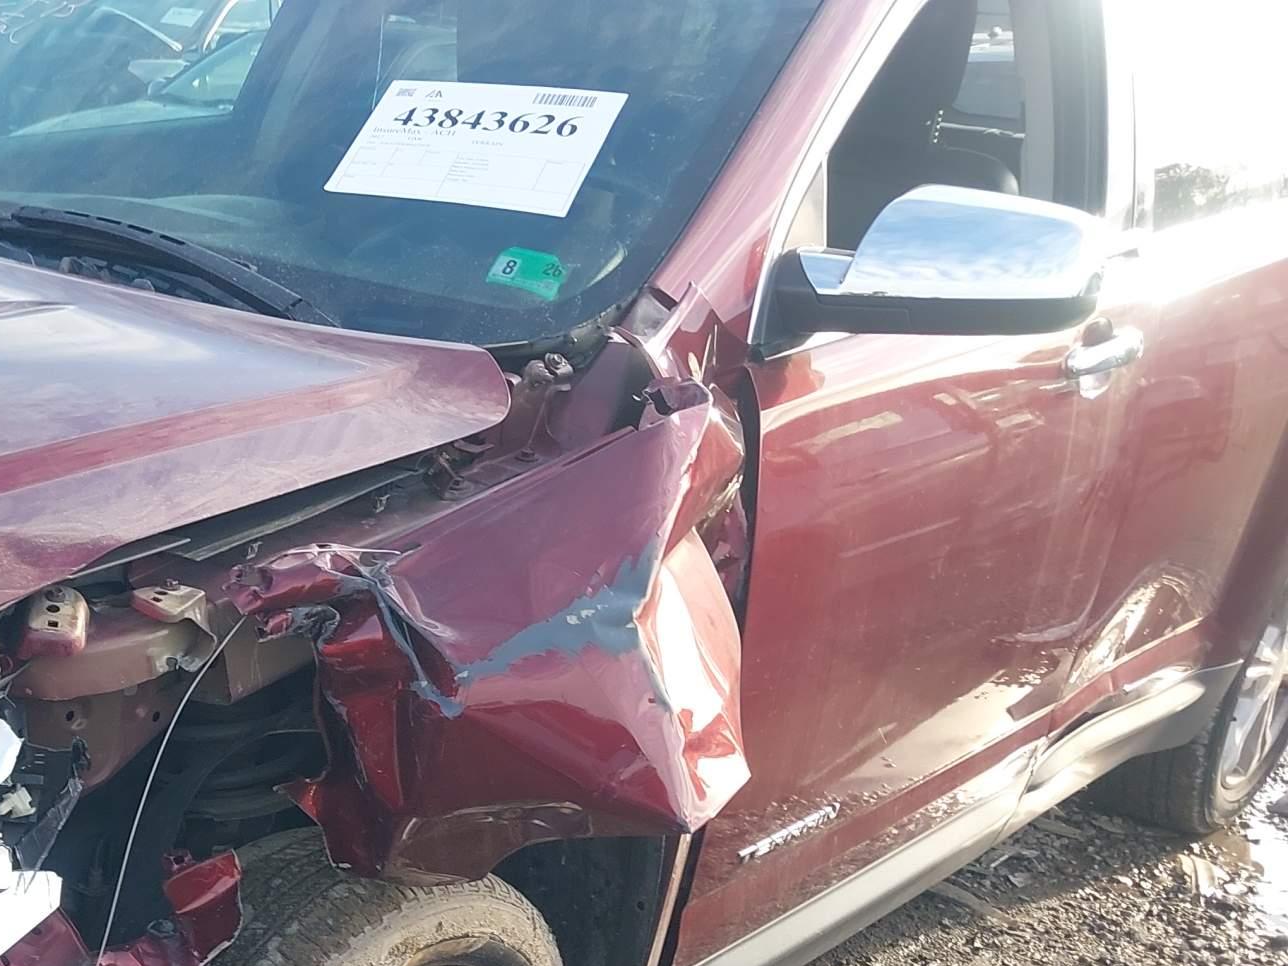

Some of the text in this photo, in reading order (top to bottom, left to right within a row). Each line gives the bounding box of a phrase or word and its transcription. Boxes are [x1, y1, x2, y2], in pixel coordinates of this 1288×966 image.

[393, 106, 585, 138] 43843626
[502, 259, 562, 277] 8 26
